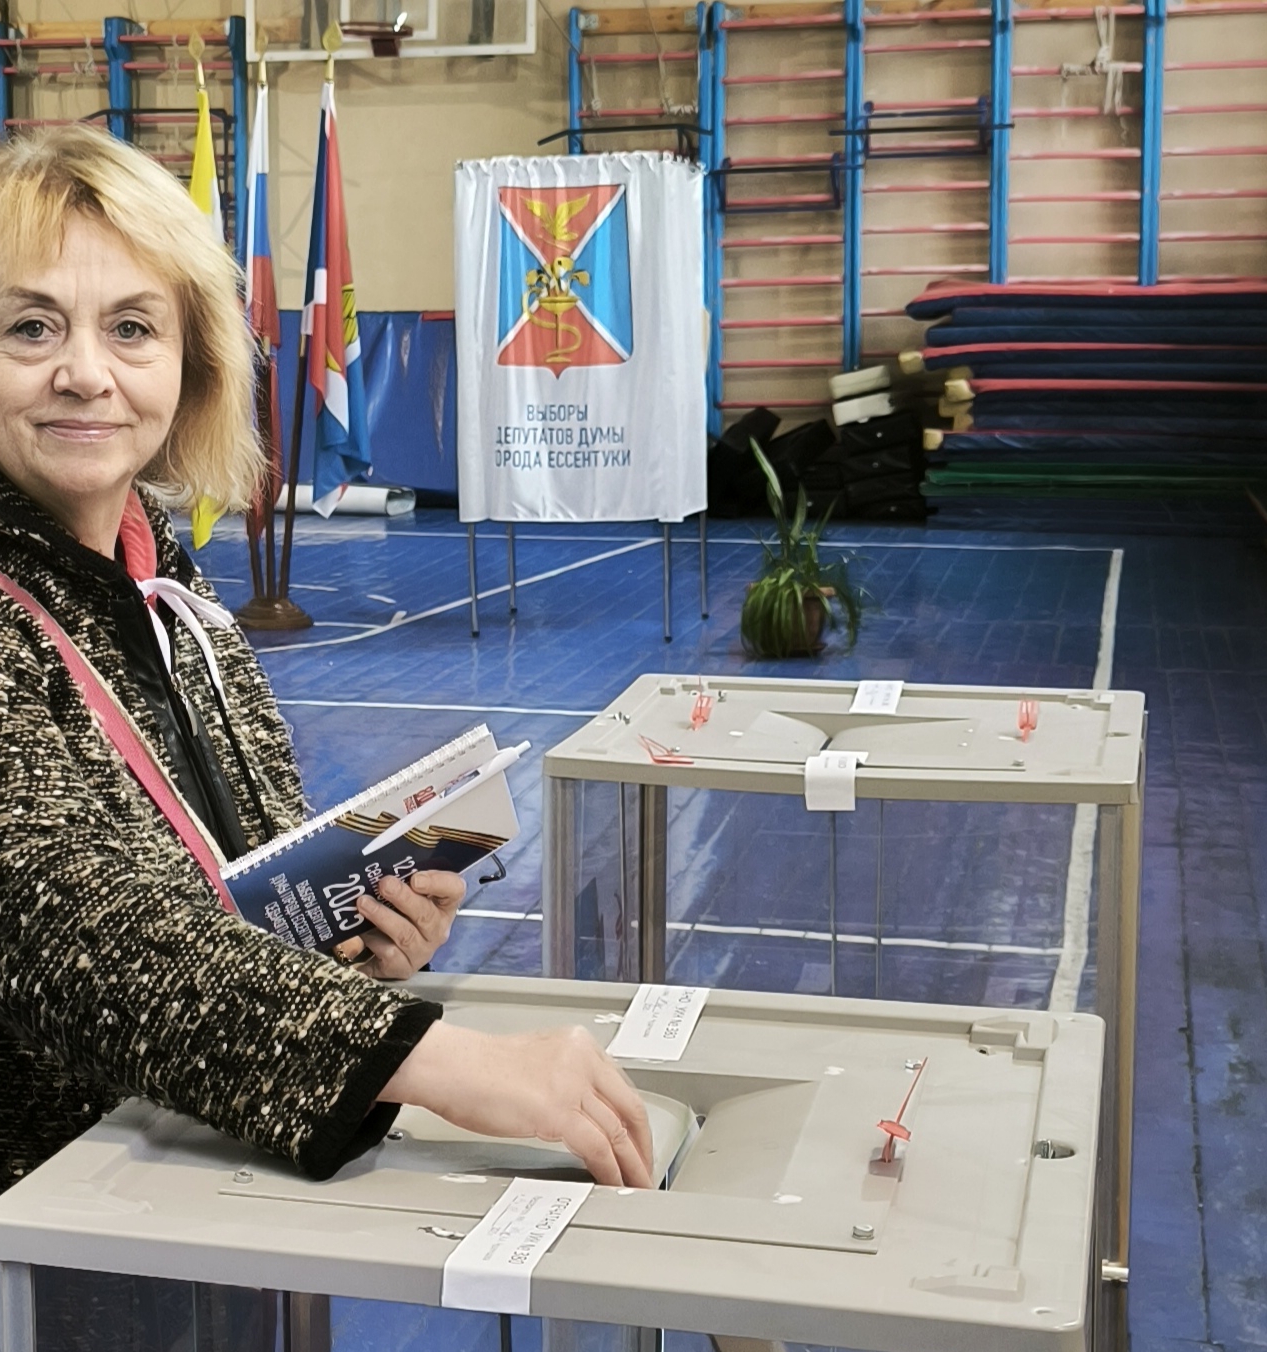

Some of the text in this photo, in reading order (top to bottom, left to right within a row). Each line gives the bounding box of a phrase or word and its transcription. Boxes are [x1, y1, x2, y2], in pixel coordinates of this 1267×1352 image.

[526, 404, 588, 421] ВЫБОРЫ
[577, 427, 625, 448] ДУМЫ
[495, 449, 631, 470] ОРОДА ЕССЕНТУКИ
